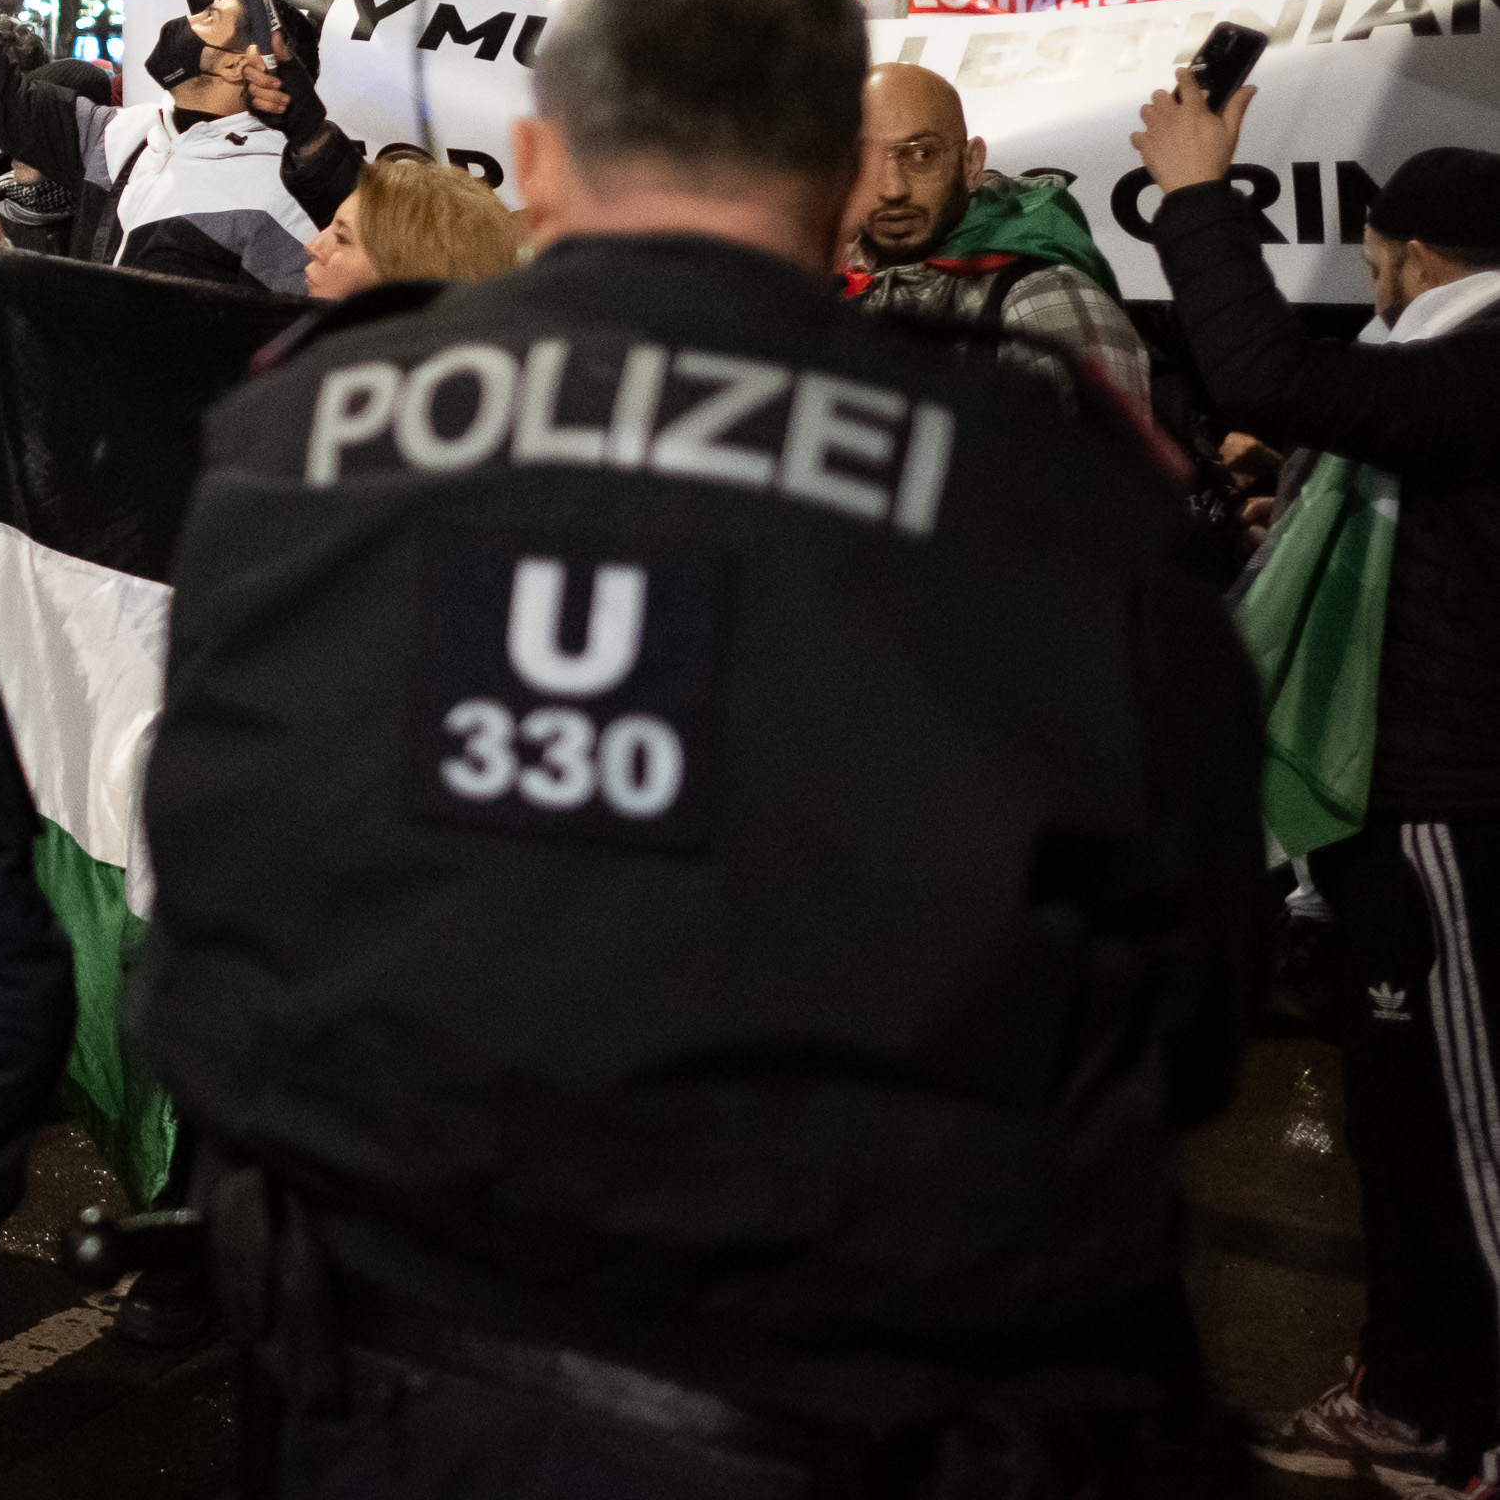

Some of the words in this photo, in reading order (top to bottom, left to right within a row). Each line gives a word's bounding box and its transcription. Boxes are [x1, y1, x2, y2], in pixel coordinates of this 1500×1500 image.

[305, 337, 956, 537] POLIZEI
[507, 556, 648, 696] U
[438, 699, 685, 818] 330
